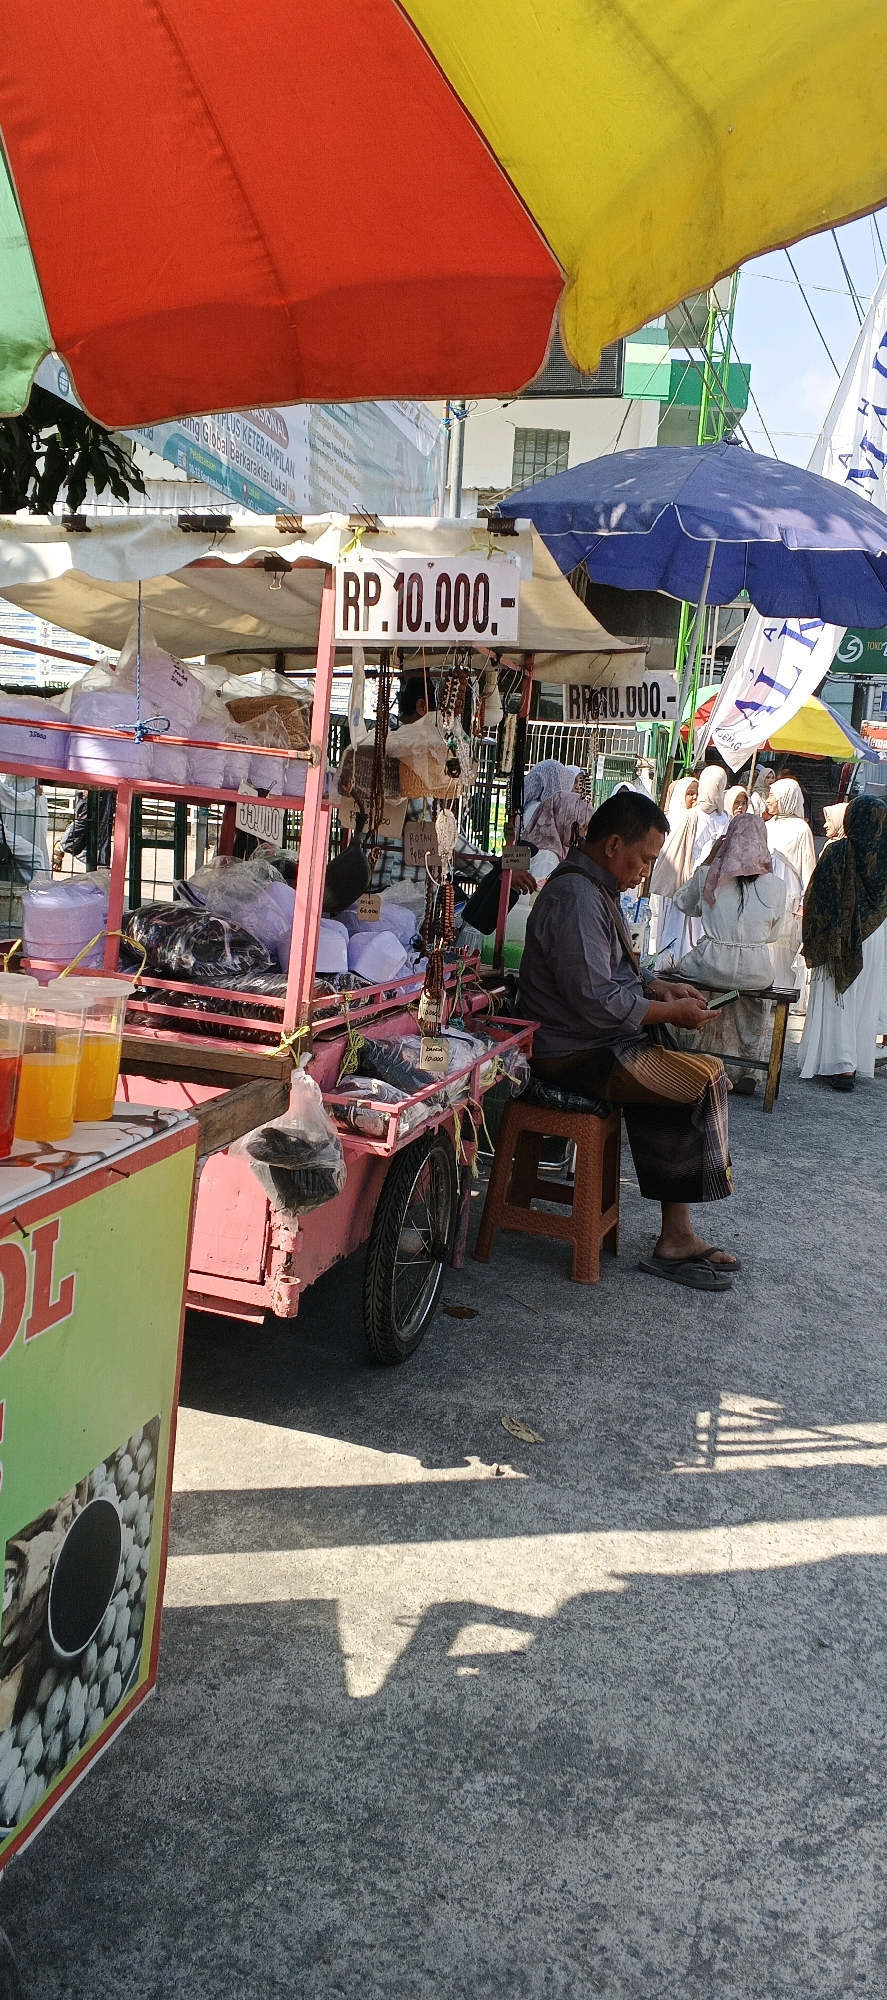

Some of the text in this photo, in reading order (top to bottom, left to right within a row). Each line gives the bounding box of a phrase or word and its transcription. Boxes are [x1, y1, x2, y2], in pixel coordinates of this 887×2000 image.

[202, 422, 228, 455] Global
[230, 440, 270, 484] Berkarakter
[270, 474, 288, 496] Lokal
[242, 422, 296, 479] KETERAMPILAN
